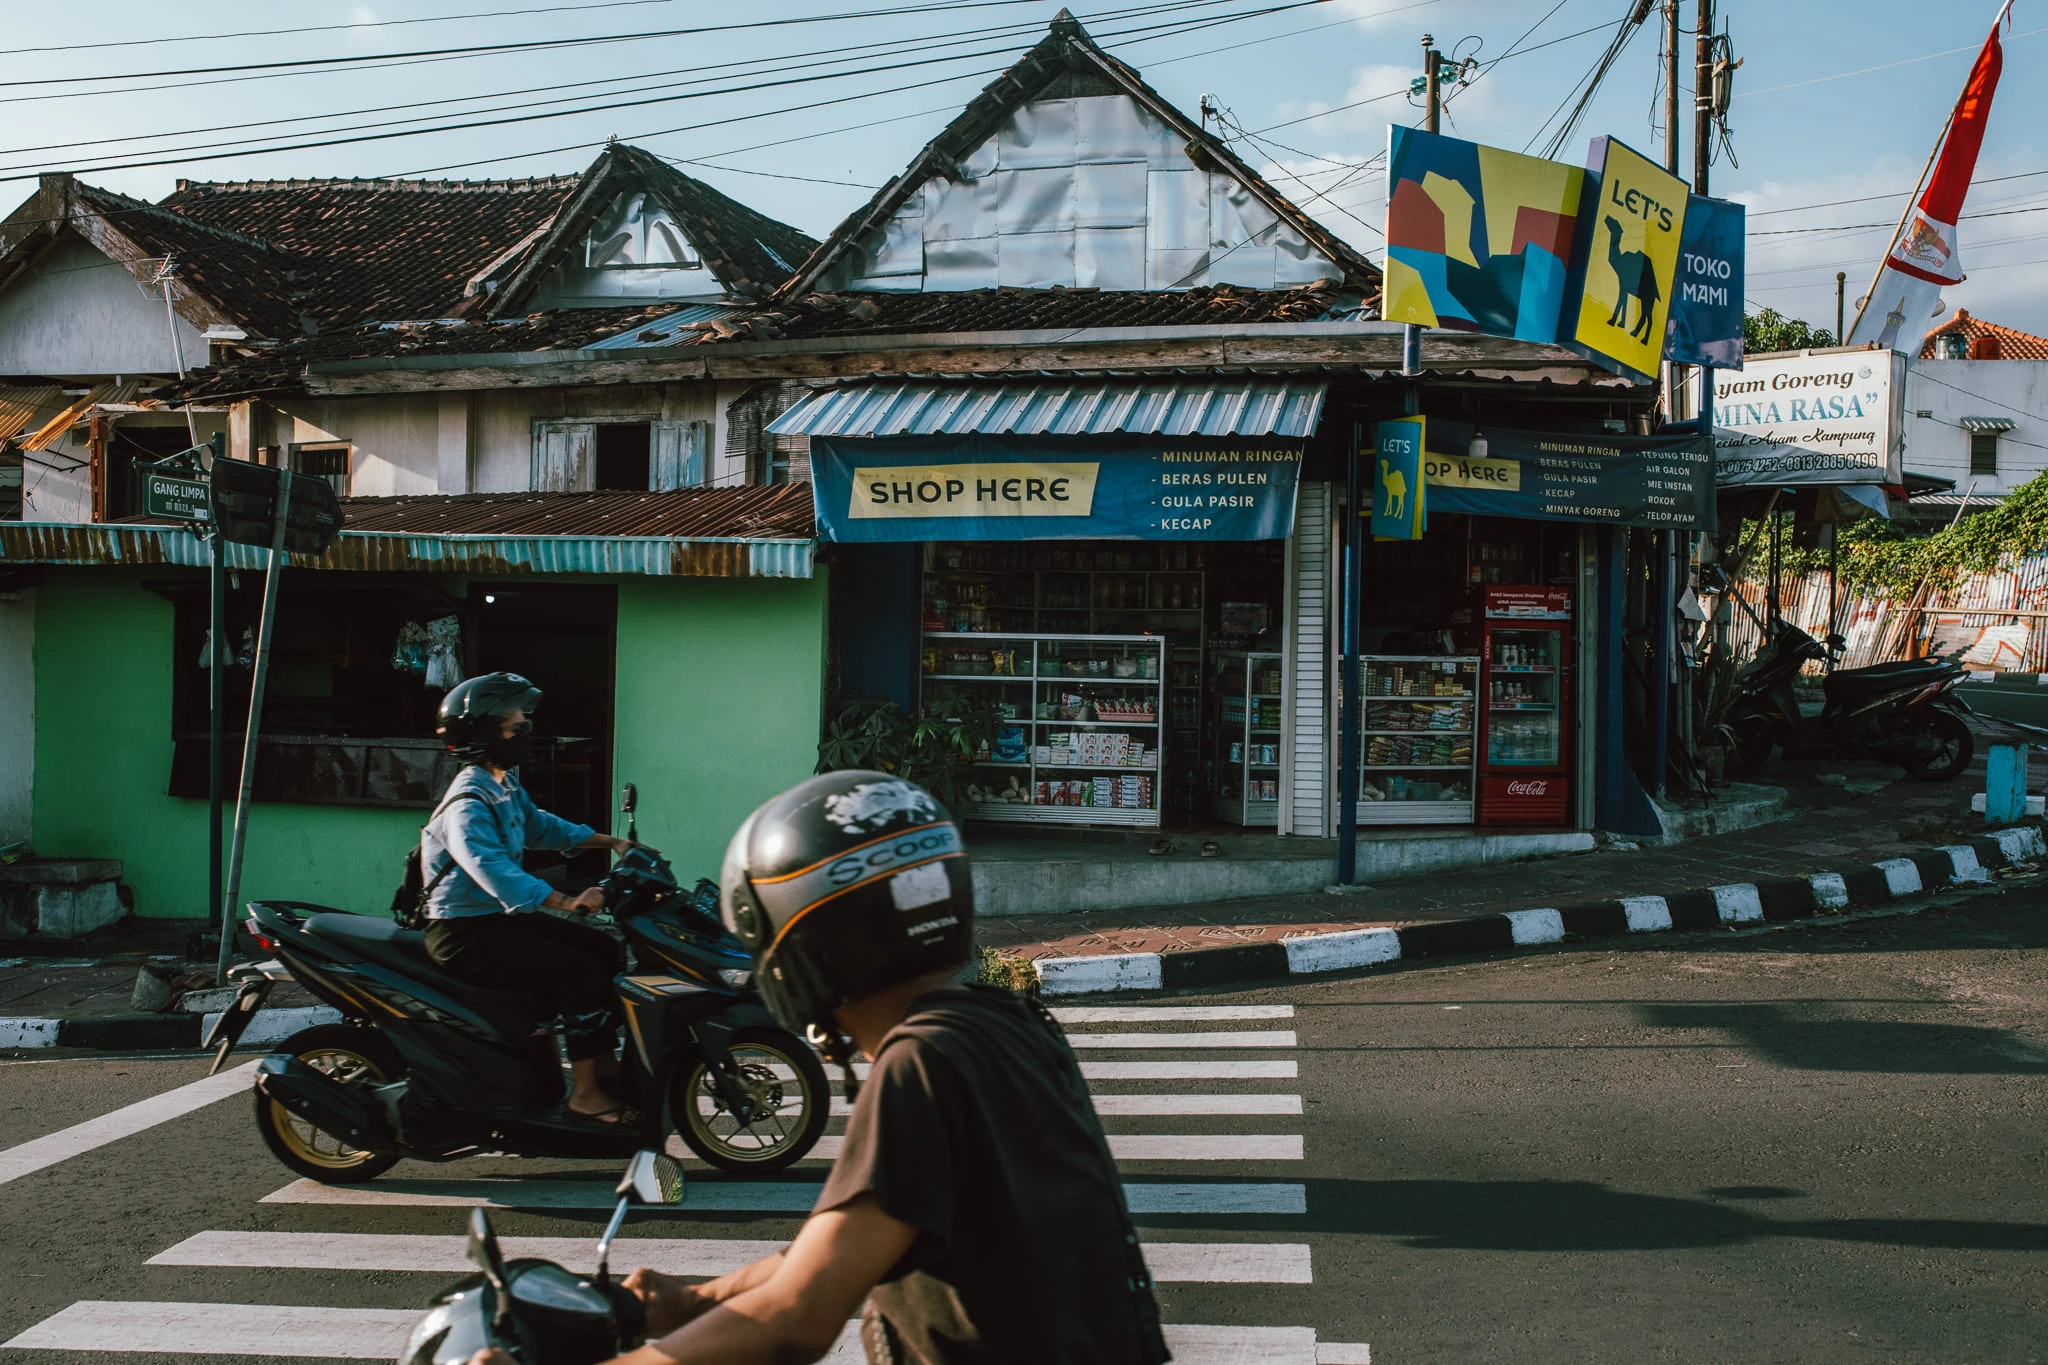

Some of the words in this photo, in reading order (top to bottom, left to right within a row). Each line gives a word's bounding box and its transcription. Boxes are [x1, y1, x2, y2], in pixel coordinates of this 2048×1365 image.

[1611, 179, 1674, 233] LET'S
[1684, 252, 1731, 280] TOKO
[1683, 281, 1728, 306] MAMI
[1771, 371, 1854, 390] Goreng
[1749, 430, 1798, 450] Ayam
[1802, 427, 1876, 448] Kampung
[1383, 438, 1411, 454] LET'S
[1540, 442, 1585, 455] MINUMAN
[1587, 446, 1621, 457] RINGAN
[1162, 450, 1240, 463] MINUMAN
[1642, 451, 1678, 460] TEPUNG
[1680, 452, 1709, 463] TERIGU
[1540, 458, 1569, 468] BERAS
[1571, 460, 1602, 470] PULEN
[1425, 461, 1452, 477] OP
[1458, 460, 1508, 482] HERE
[1646, 465, 1660, 473] AIR
[1663, 466, 1690, 476] GALON
[1162, 473, 1212, 485] BERAS
[1217, 473, 1267, 484] PULEN
[1543, 473, 1569, 482] GULA
[1571, 474, 1598, 484] PASIR
[154, 481, 179, 497] GANG
[181, 485, 206, 500] LIMPA
[871, 479, 964, 504] SHOP
[976, 478, 1070, 502] HERE
[1647, 480, 1662, 489] MIE
[1664, 481, 1693, 492] INSTAN
[1545, 489, 1575, 498] KECAP
[1161, 496, 1203, 507] GULA
[1209, 496, 1254, 507] PASIR
[1648, 495, 1675, 505] ROKOK
[1546, 505, 1580, 515] MINYAK
[1583, 506, 1620, 517] GORENG
[1647, 511, 1672, 521] TELOR
[1673, 513, 1695, 523] AYAM
[1161, 518, 1212, 530] KECAP
